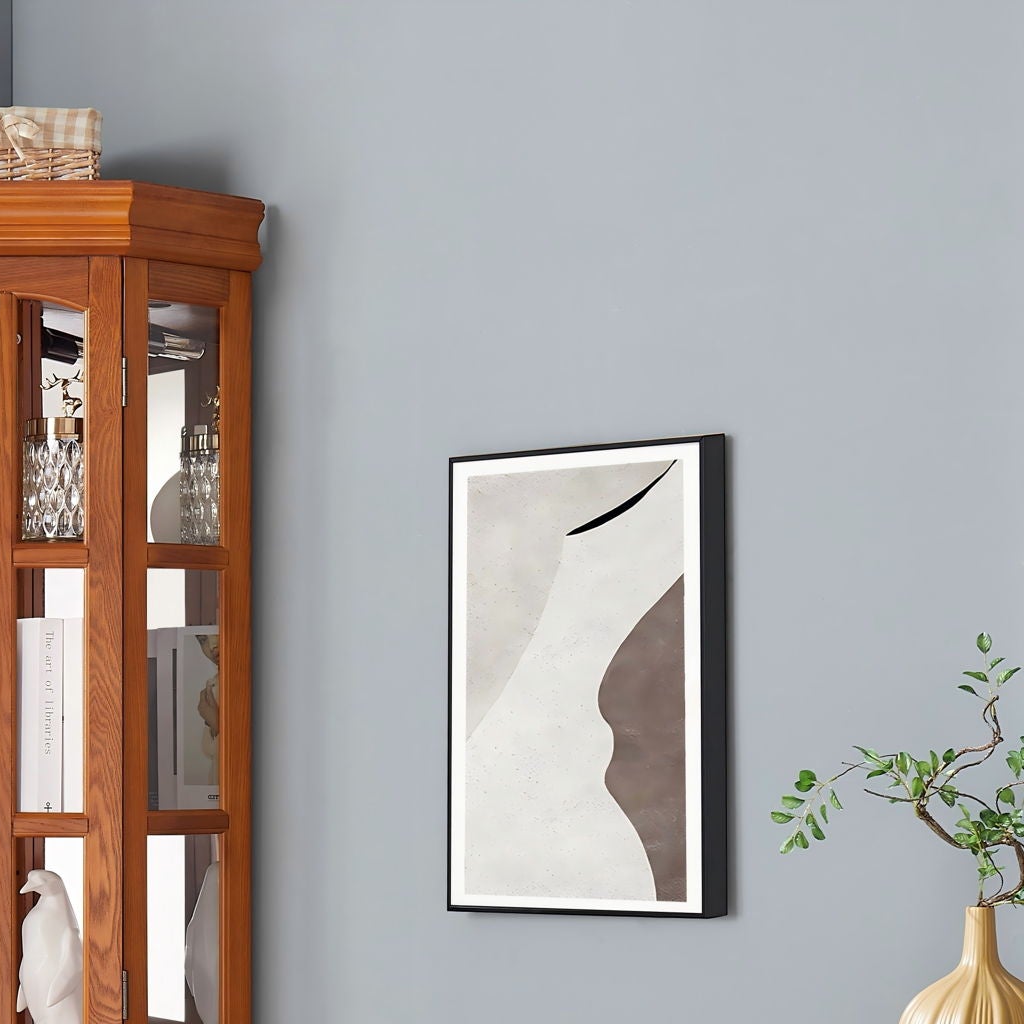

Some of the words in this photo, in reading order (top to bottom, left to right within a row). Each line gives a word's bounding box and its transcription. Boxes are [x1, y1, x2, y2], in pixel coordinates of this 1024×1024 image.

[45, 631, 54, 650] The
[45, 680, 54, 694] of
[45, 700, 54, 755] libraries
